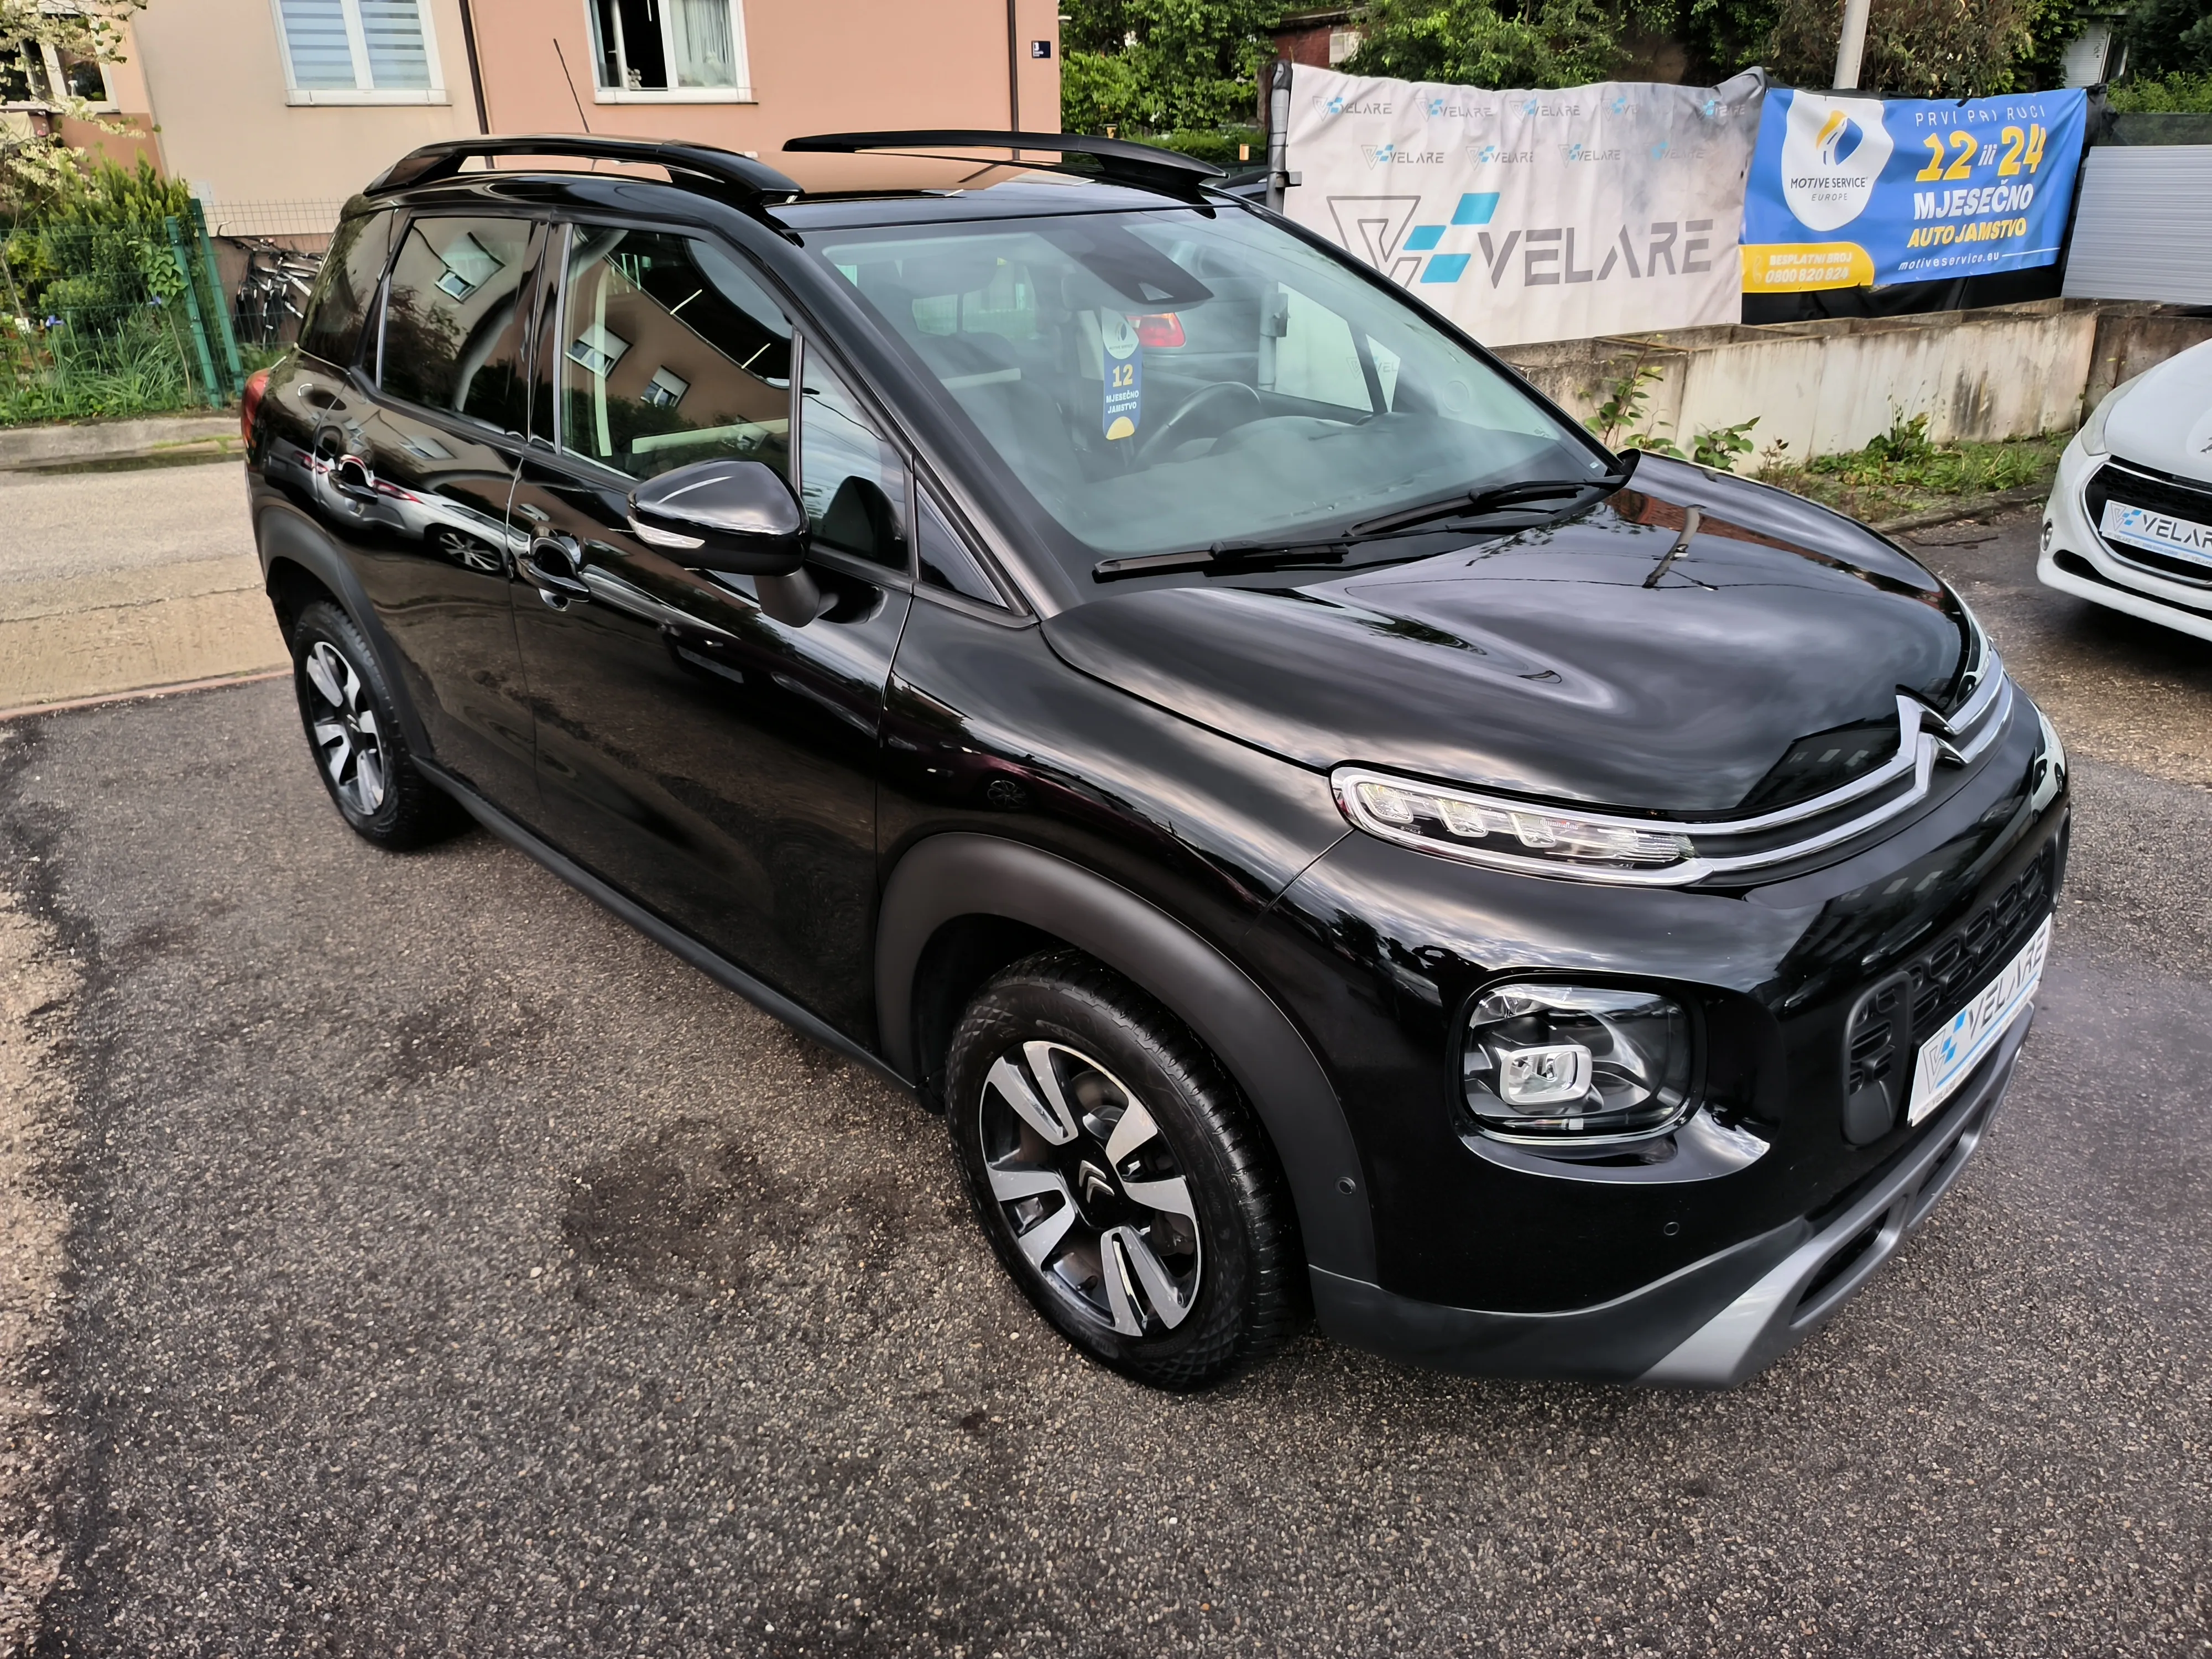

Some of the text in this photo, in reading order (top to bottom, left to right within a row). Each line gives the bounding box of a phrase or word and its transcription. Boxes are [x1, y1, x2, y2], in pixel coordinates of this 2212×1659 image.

[1339, 103, 1392, 115] VELARE
[1439, 106, 1493, 118] VELARE
[1915, 111, 1957, 127] PRVI
[2007, 105, 2046, 121] RUCI
[1390, 152, 1444, 164] VELARE
[1577, 149, 1621, 161] VELARE
[1915, 123, 2046, 182] 12 ili 24
[1791, 177, 1866, 189] MOTIVE SERVICE
[1811, 193, 1848, 201] EUROPE
[1914, 179, 2034, 220] MJESEČNO
[1478, 219, 1713, 289] VELARE
[1769, 252, 1852, 266] BESPLATNI BROJ
[1898, 252, 2000, 271] motiveservice.eu
[1765, 267, 1849, 284] 0800 820 824
[1113, 364, 1133, 388] 12
[1106, 390, 1139, 403] MJESEČNO
[1107, 401, 1137, 414] JAMSTVO
[1969, 928, 2046, 1040] VELARE
